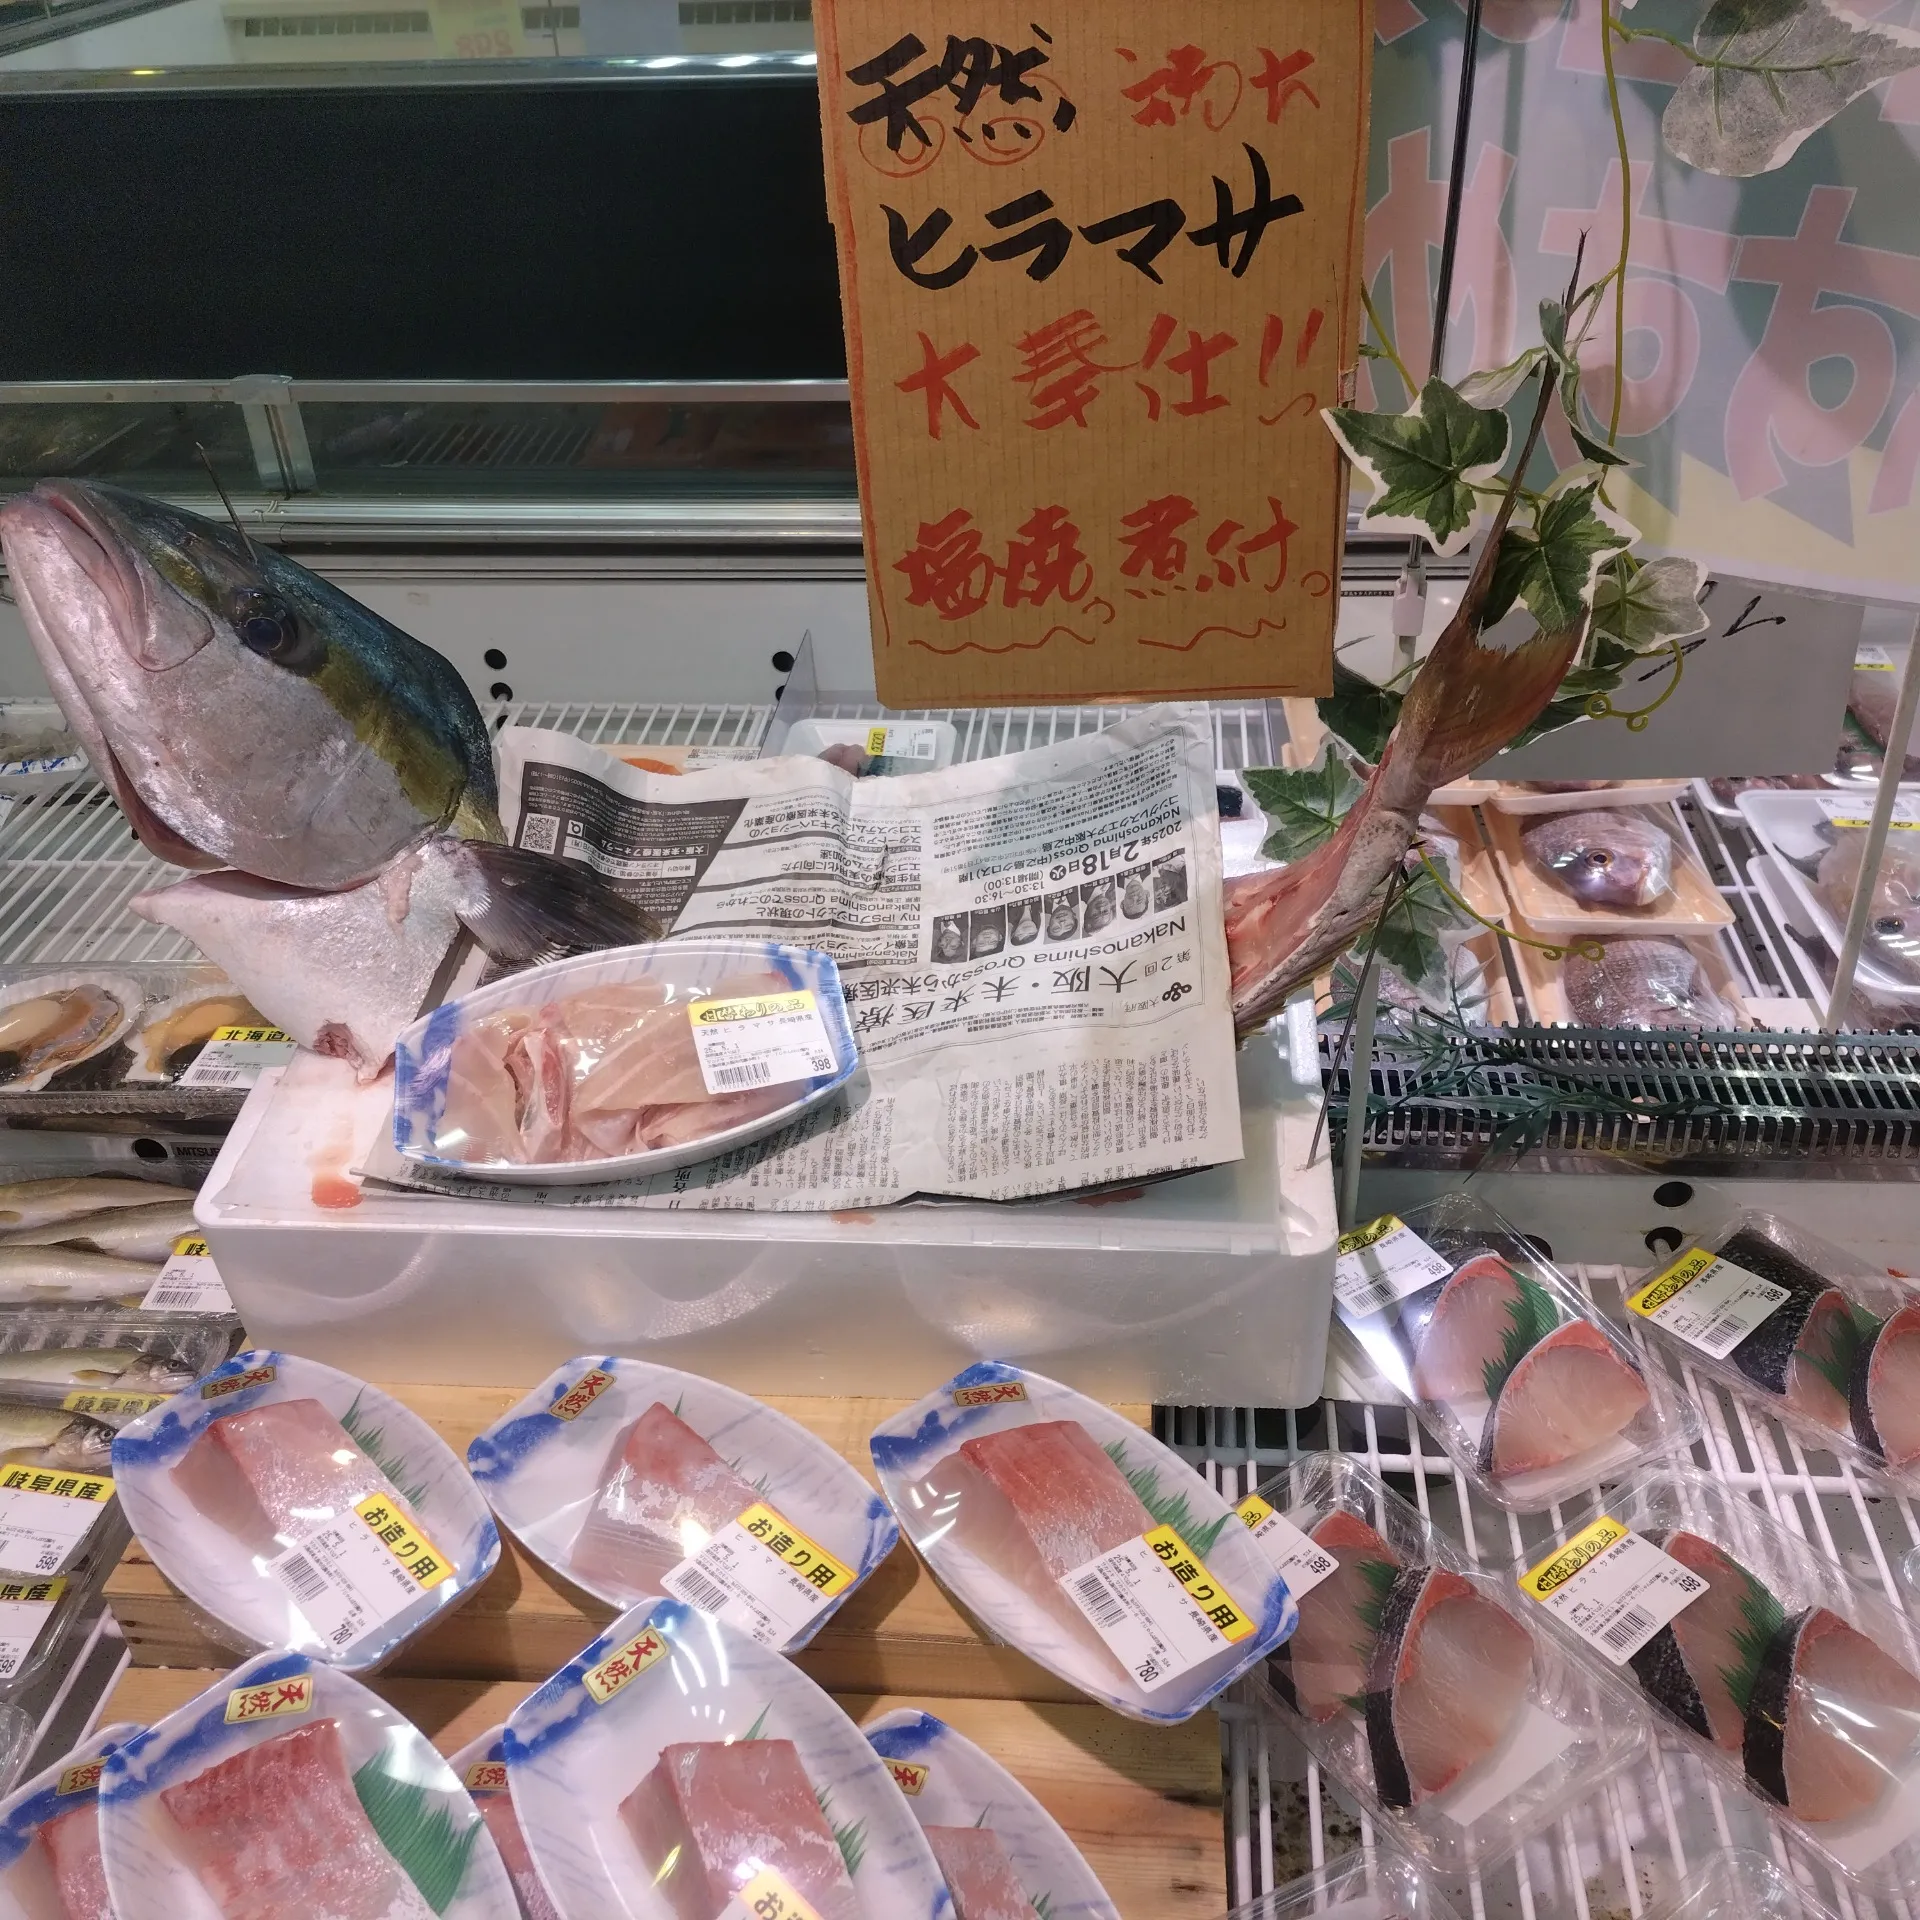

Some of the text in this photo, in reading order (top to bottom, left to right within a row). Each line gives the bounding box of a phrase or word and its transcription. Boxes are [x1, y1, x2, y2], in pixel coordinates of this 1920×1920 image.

[879, 142, 1304, 290] ヒラマサ
[1094, 805, 1180, 847] Nakanoshima
[831, 895, 920, 912] Nakanoshima
[1036, 915, 1185, 964] Nakanoshima
[1144, 949, 1191, 974] 第2回
[222, 1031, 294, 1041] 北海道
[811, 1058, 832, 1072] 398
[184, 1243, 212, 1255] 岐
[1427, 1262, 1446, 1276] 498
[1764, 1288, 1784, 1302] 498
[562, 1374, 607, 1416] 天然
[3, 1470, 105, 1499] 岐阜県産
[363, 1507, 439, 1580] お造り用
[747, 1518, 837, 1588] お造り用
[35, 1555, 59, 1570] 598
[1310, 1556, 1331, 1574] 498
[1537, 1529, 1618, 1591] 日替わりの品
[1551, 1593, 1569, 1608] 天然
[1609, 1538, 1637, 1561] 長崎県産
[788, 1576, 820, 1603] 長崎県産
[1153, 1541, 1239, 1630] お造り用
[1678, 1575, 1701, 1593] 498
[329, 1623, 353, 1645] 780
[1189, 1610, 1219, 1644] 長崎県産
[596, 1637, 660, 1693] 天然
[1135, 1660, 1159, 1683] 780
[235, 1682, 309, 1719] 天然
